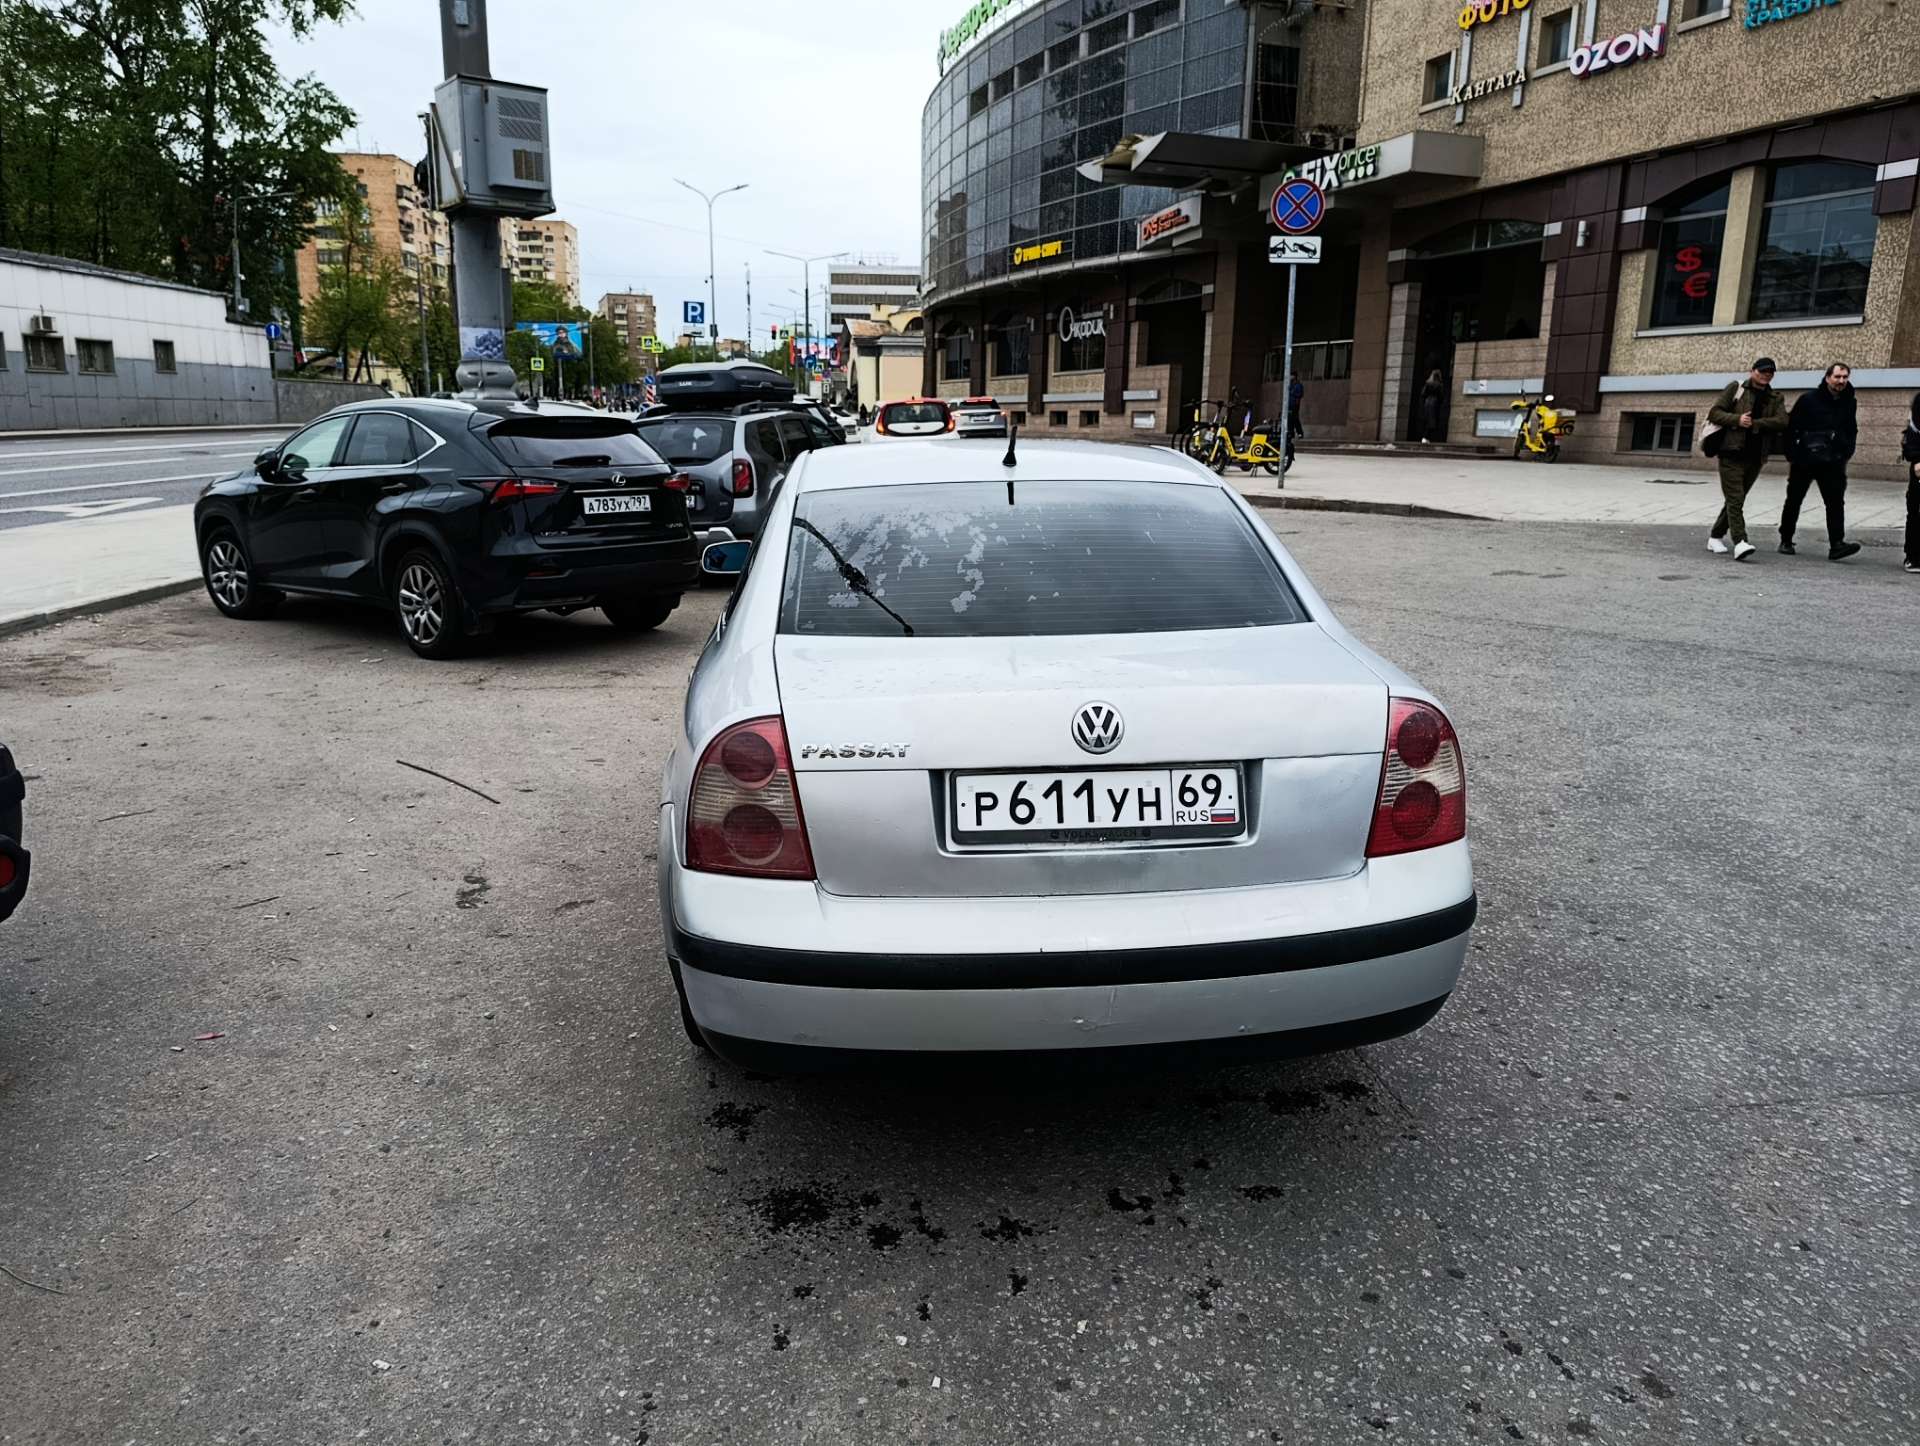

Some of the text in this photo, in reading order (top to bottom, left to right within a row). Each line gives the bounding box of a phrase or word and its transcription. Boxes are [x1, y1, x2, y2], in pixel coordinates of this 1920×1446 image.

[1569, 23, 1665, 76] OZON
[801, 741, 911, 759] PASSAT
[975, 773, 1222, 826] Р611УН 69
[1176, 809, 1209, 823] RUS
